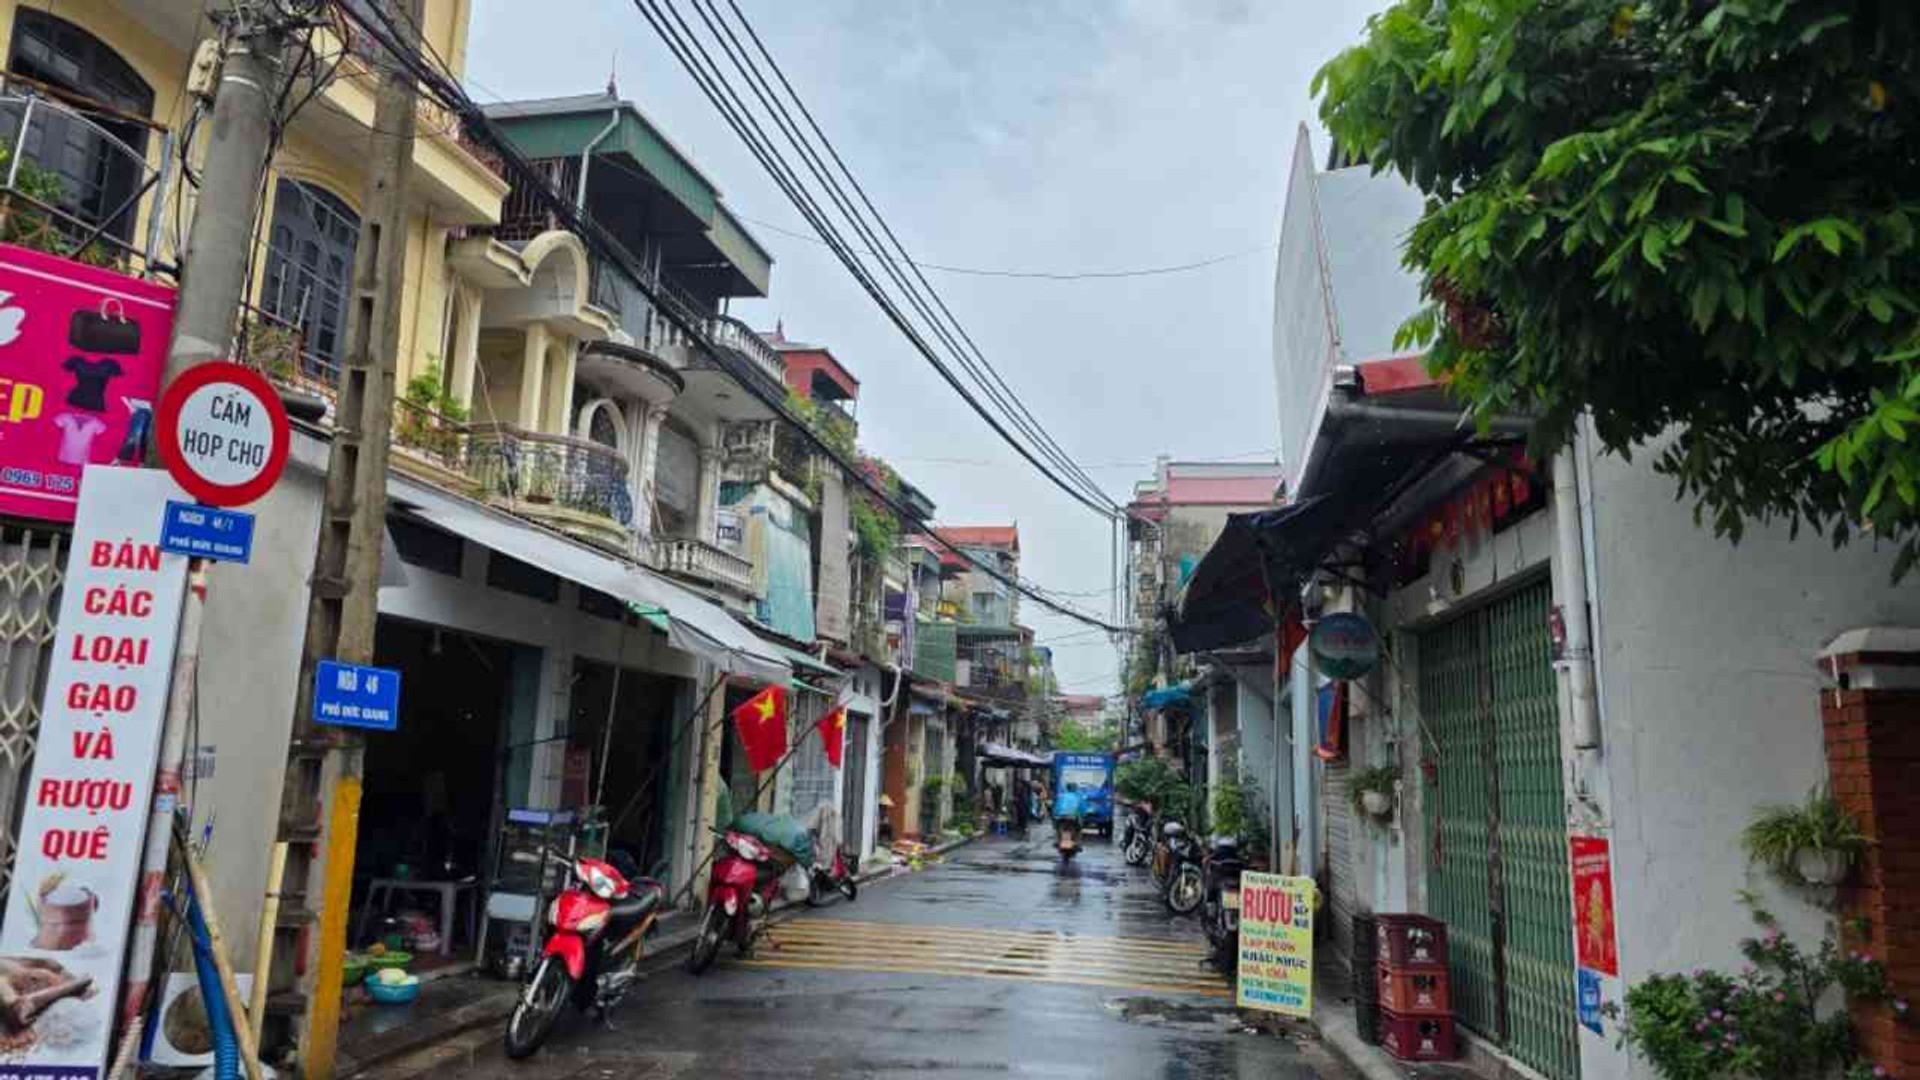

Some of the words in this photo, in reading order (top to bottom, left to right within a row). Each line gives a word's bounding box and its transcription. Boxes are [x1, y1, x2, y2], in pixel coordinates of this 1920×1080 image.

[210, 390, 251, 428] CẤM
[184, 428, 223, 460] HỌP
[228, 438, 265, 471] CHỢ
[90, 537, 161, 572] BÁN
[84, 583, 154, 618] CÁC
[72, 633, 149, 670] LOẠI
[66, 681, 137, 718] GẠO
[72, 726, 115, 760] VÀ
[37, 777, 133, 816] RƯỢU
[41, 825, 110, 861] QUÊ
[1243, 887, 1292, 929] RƯỢU
